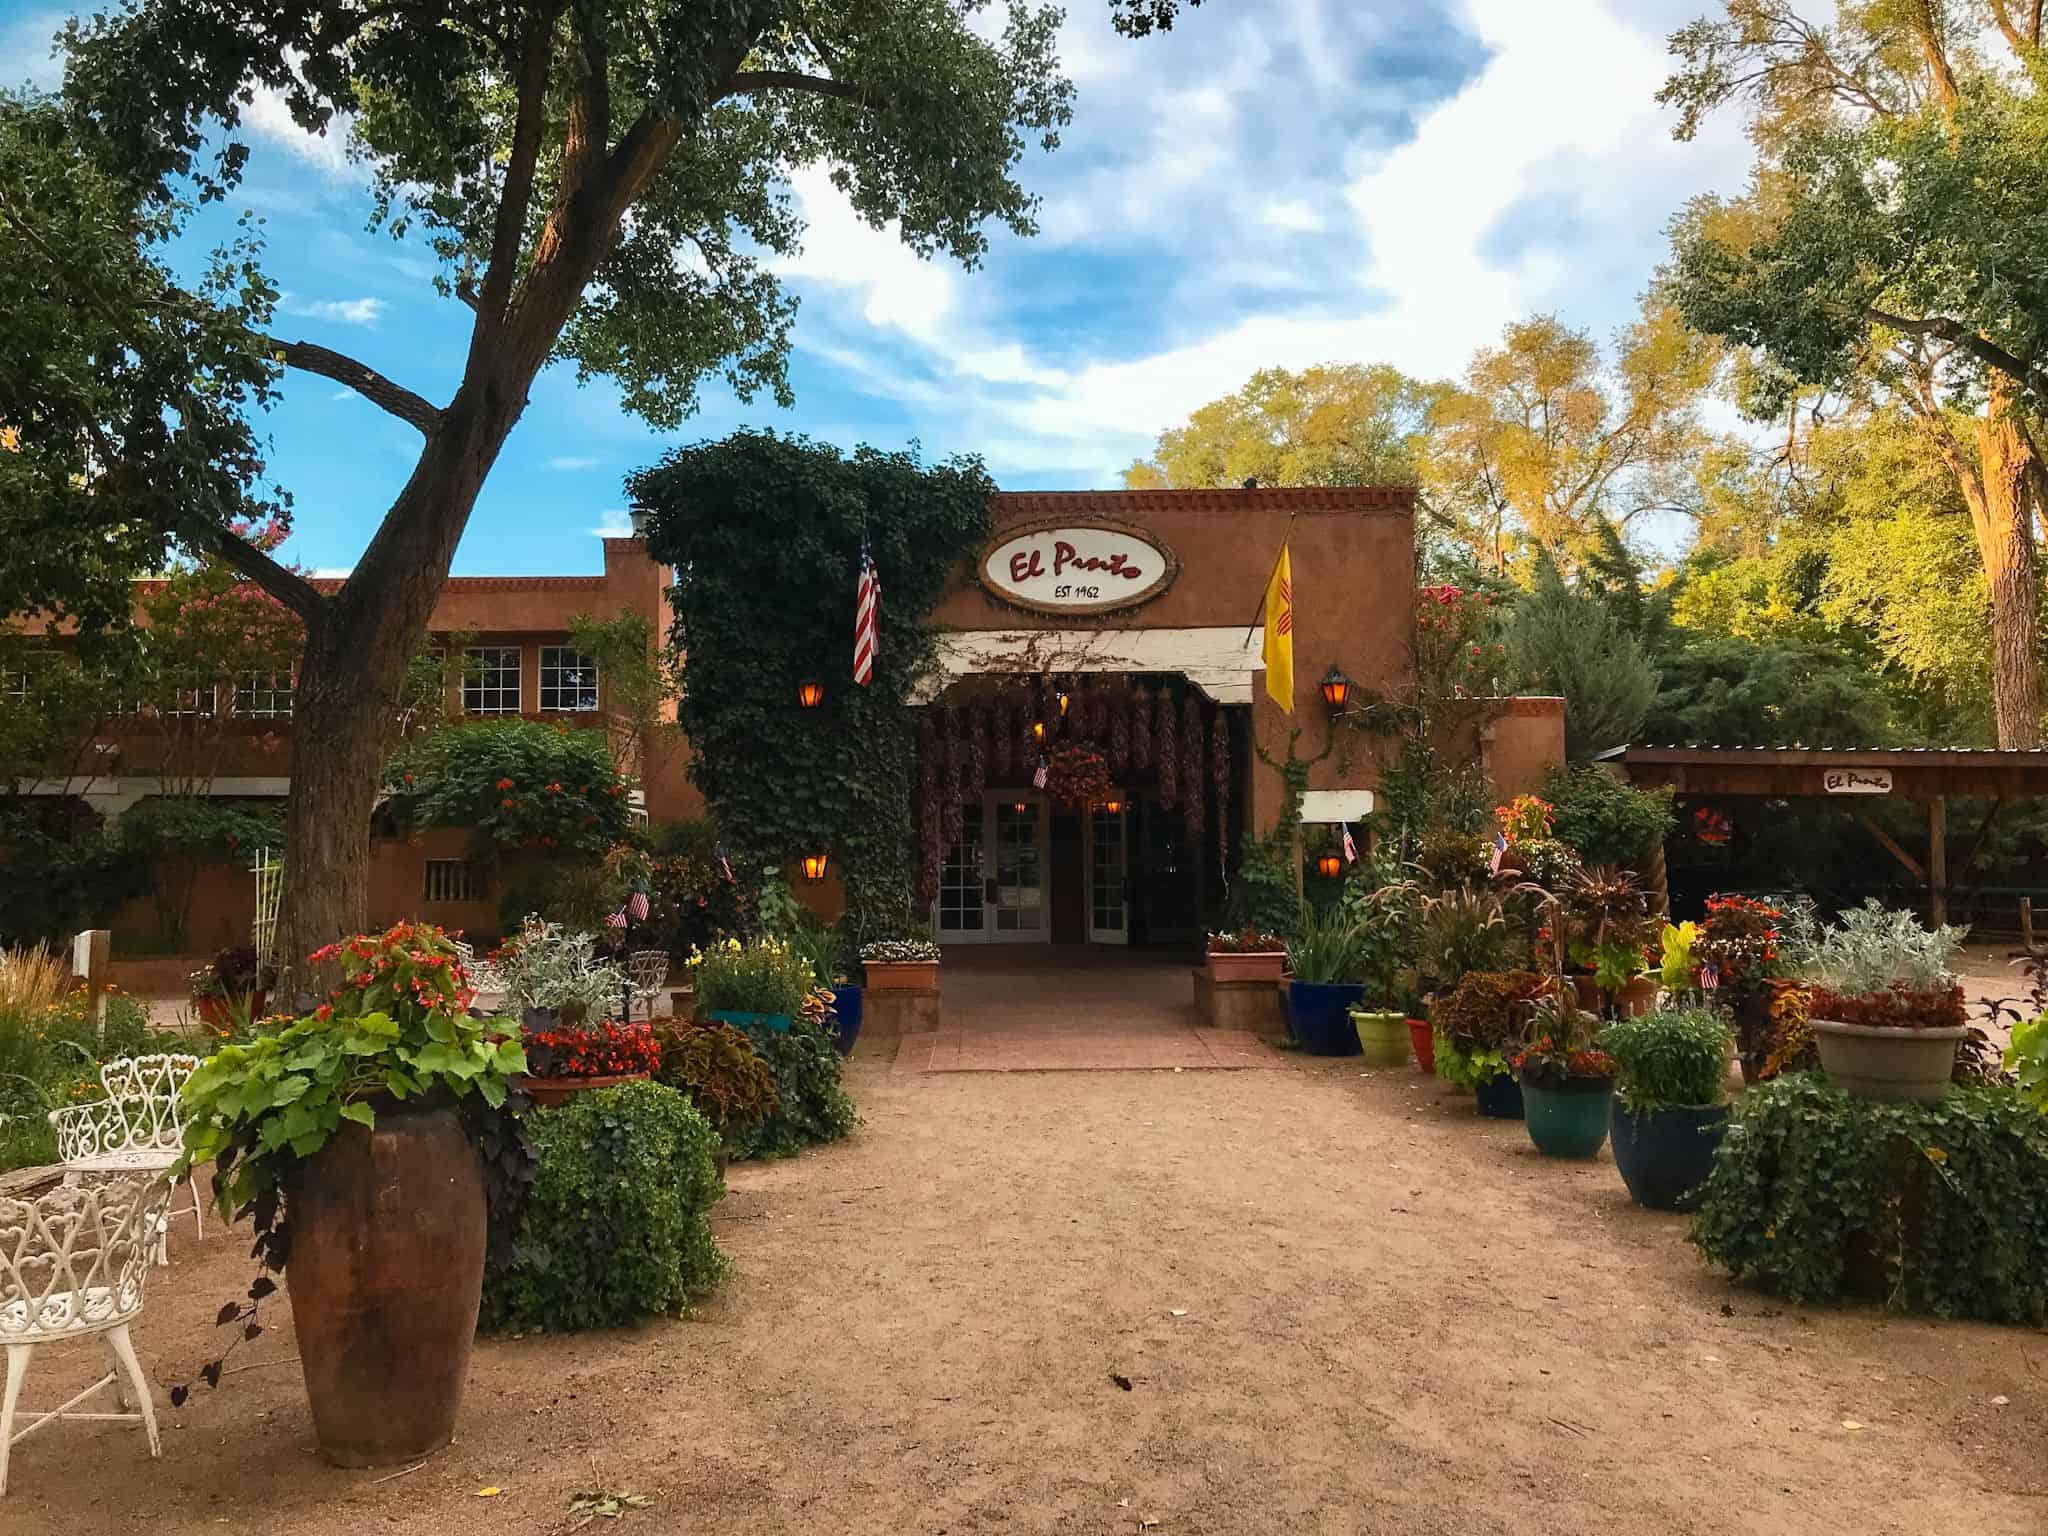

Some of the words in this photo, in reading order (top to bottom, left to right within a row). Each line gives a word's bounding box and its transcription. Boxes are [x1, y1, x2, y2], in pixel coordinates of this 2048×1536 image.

[1009, 550, 1046, 582] El
[1055, 586, 1073, 598] EST
[1074, 586, 1100, 599] 1962
